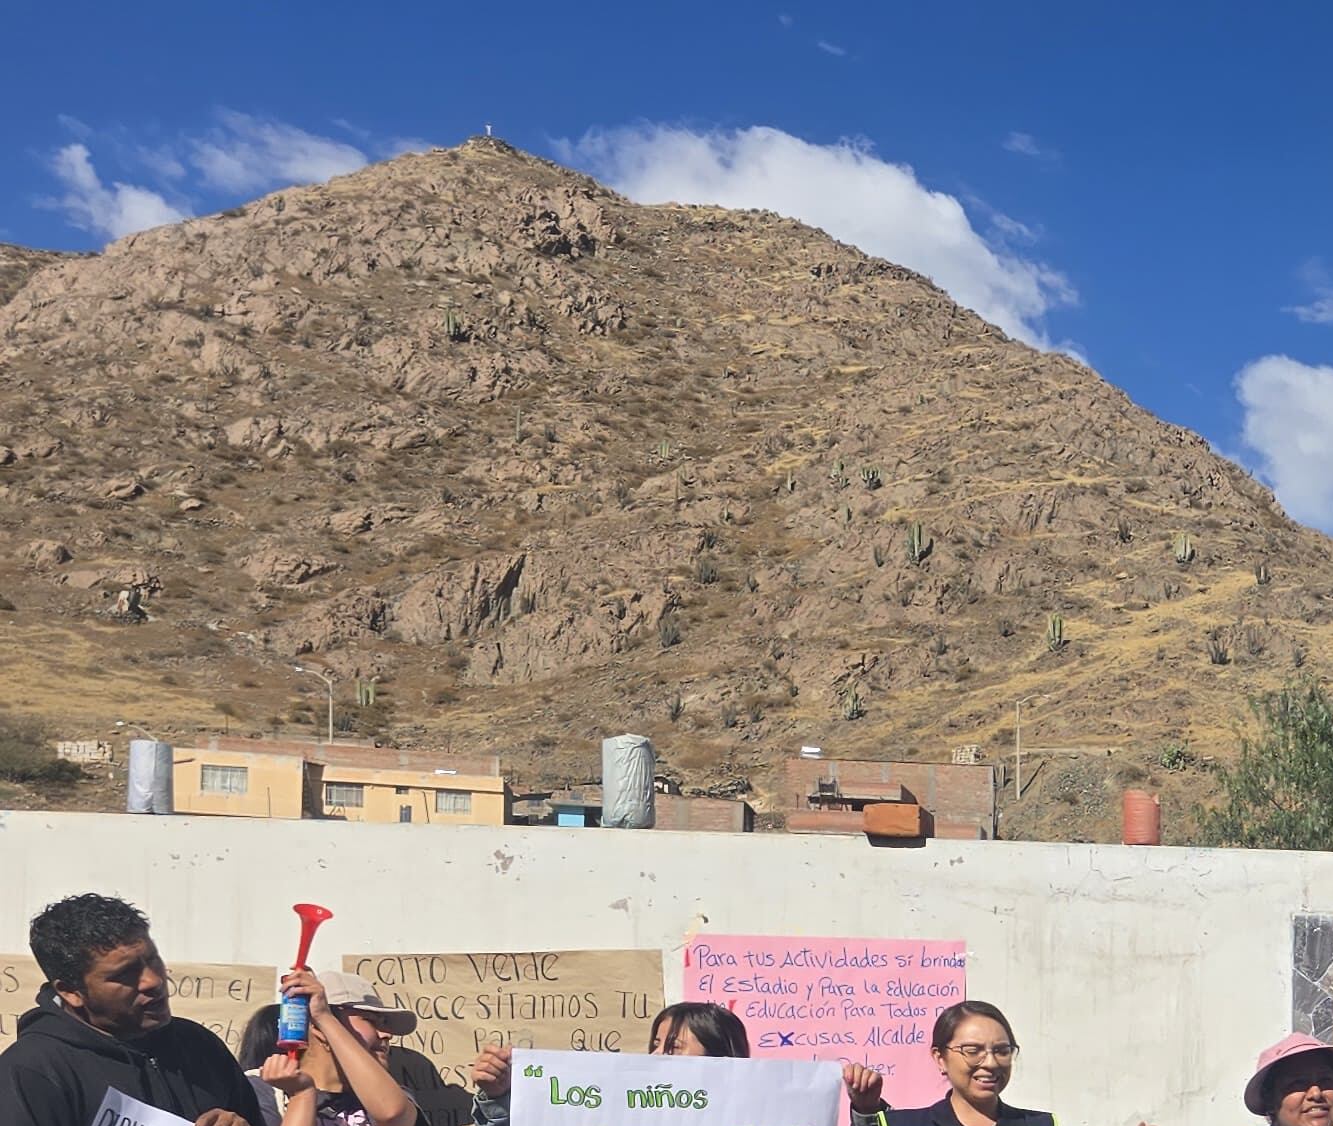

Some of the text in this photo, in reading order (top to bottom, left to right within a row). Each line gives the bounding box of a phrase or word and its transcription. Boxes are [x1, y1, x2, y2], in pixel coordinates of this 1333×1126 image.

[748, 952, 774, 967] tus
[700, 974, 714, 992] El
[723, 976, 798, 994] Estadio
[864, 980, 879, 994] la
[887, 980, 960, 997] Educación
[746, 1000, 834, 1018] Educación
[865, 1024, 924, 1046] Alcalde
[627, 1083, 708, 1109] niños
